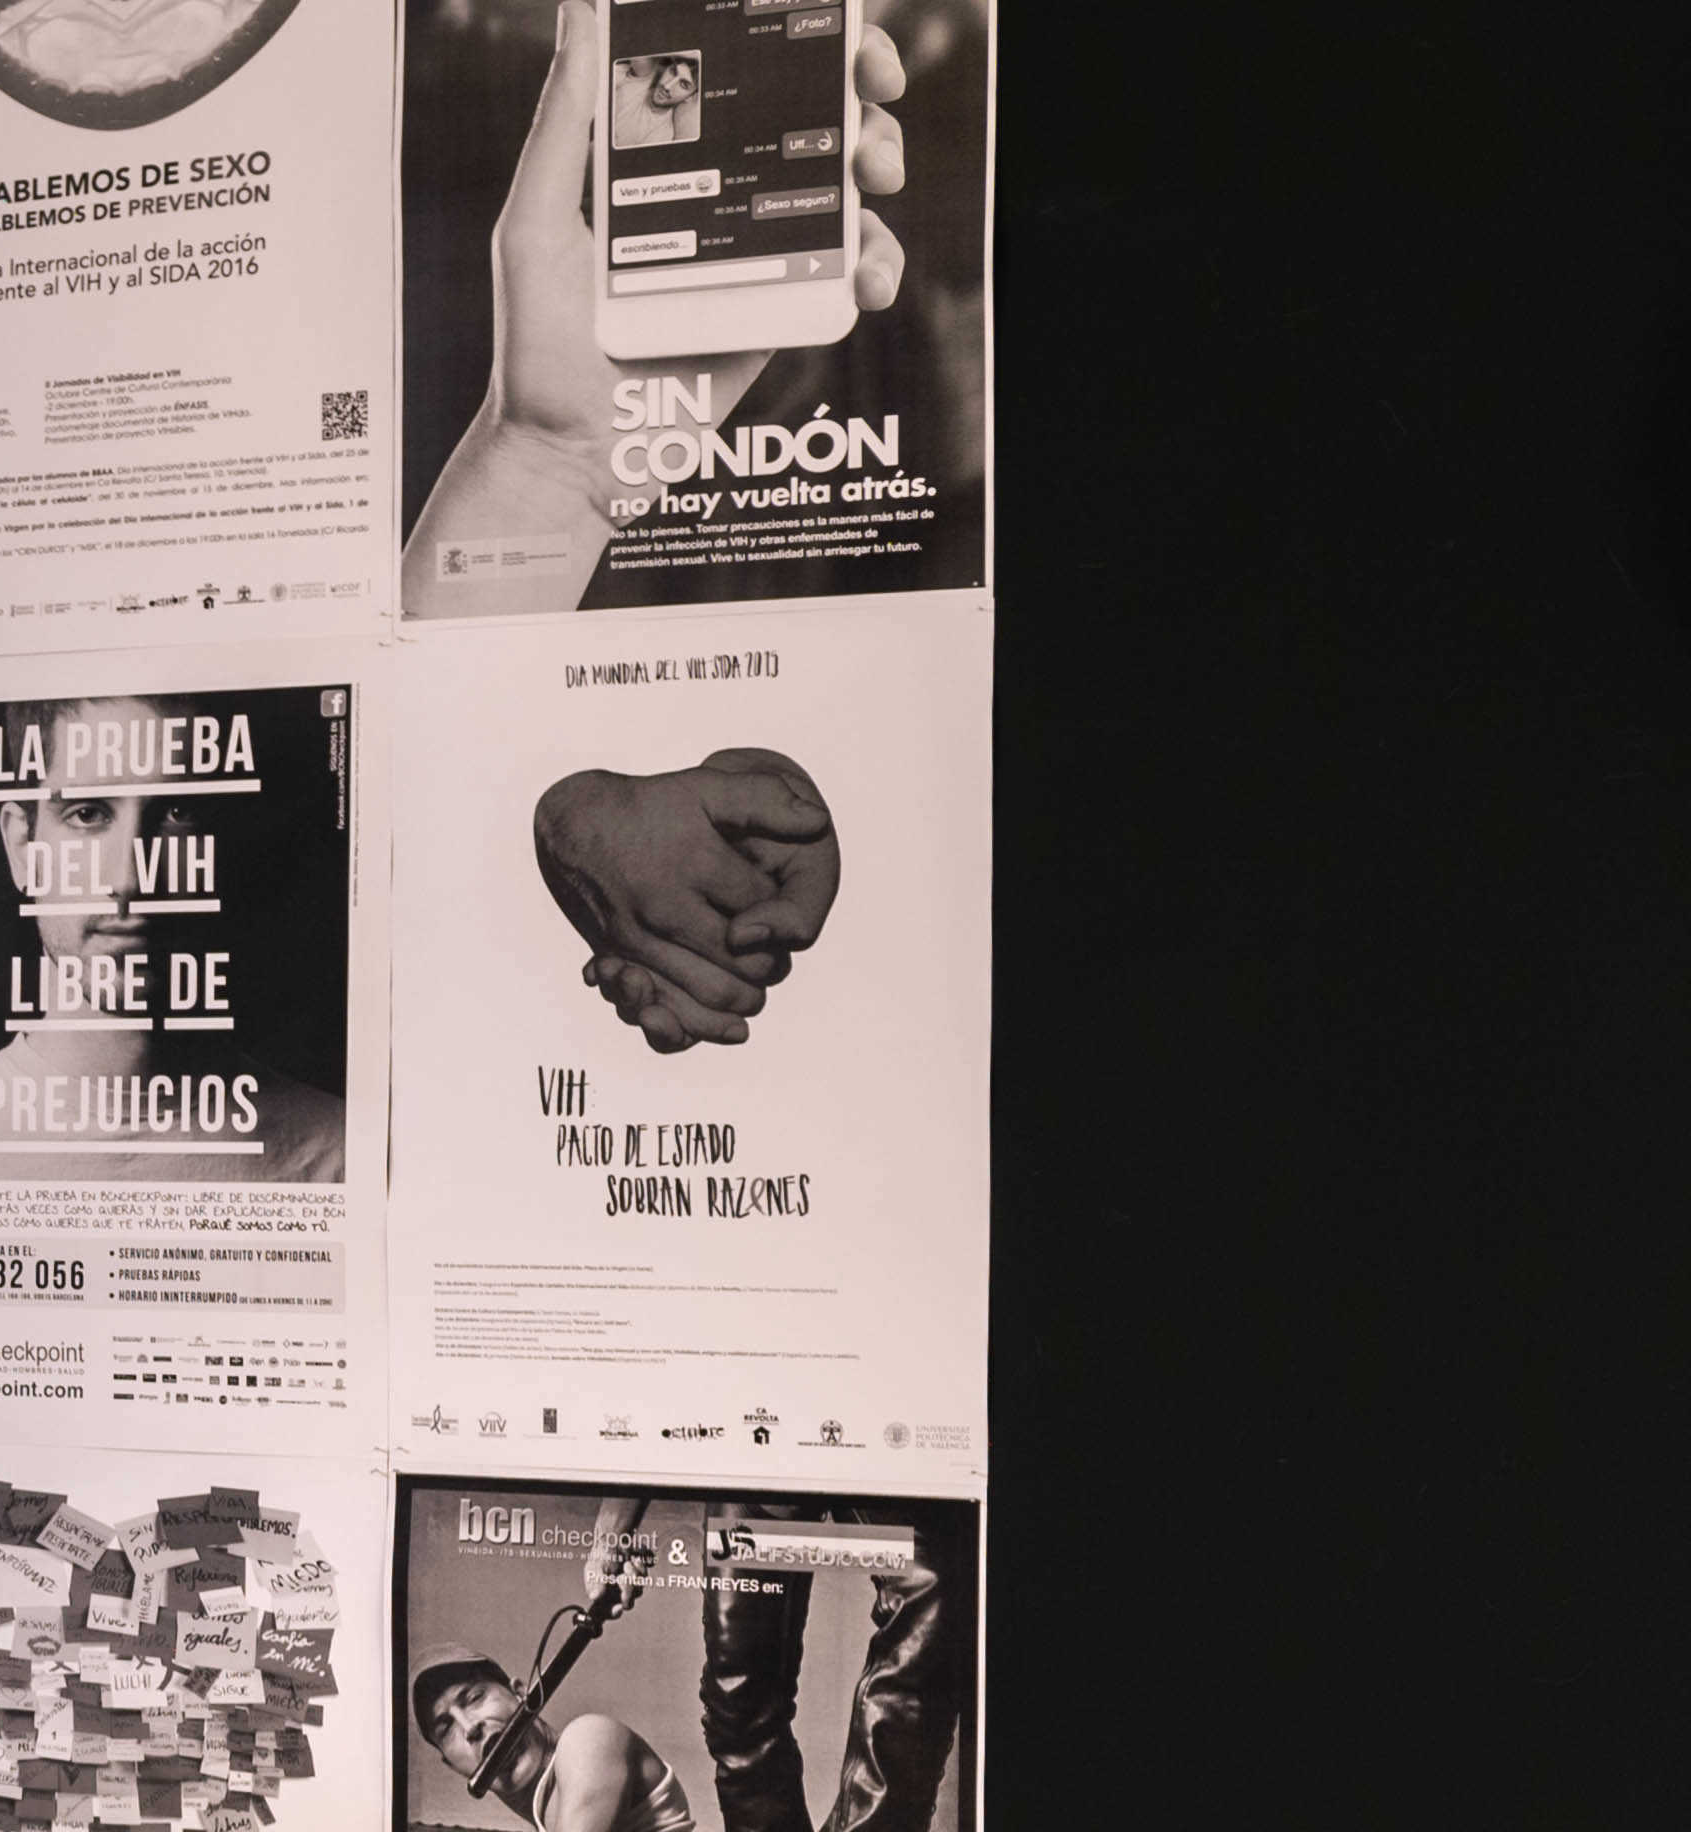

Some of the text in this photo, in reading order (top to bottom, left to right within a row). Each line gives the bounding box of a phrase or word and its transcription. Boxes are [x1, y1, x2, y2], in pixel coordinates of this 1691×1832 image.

[141, 161, 179, 187] DE
[190, 150, 271, 181] SEXO
[651, 182, 691, 195] pruebas
[93, 201, 121, 221] DE
[128, 184, 271, 218] PREVENCIÓN
[10, 246, 138, 276] Internacional
[144, 241, 170, 262] de
[177, 240, 194, 258] la
[200, 233, 266, 257] acción
[43, 277, 59, 296] al
[66, 270, 102, 294] VIH
[109, 276, 120, 294] y
[127, 268, 143, 288] al
[150, 262, 202, 286] SIDA
[207, 257, 259, 279] 2016
[611, 373, 712, 431] SIN
[610, 403, 899, 485] CONDÓN
[611, 470, 937, 519] no hay vuelta atrás.
[697, 523, 728, 534] Tomar
[731, 519, 800, 533] precauciones
[830, 513, 868, 525] manera
[921, 509, 934, 518] de
[592, 661, 651, 685] MUNDIAL
[656, 659, 679, 680] DEL
[66, 714, 256, 779] PRUEBA
[26, 834, 215, 897] DEL VIH
[10, 952, 230, 1013] LIBRE DE
[557, 1123, 735, 1167] PACTO DE ESTADO
[607, 1174, 691, 1217] SOBRAN
[36, 1260, 84, 1289] 056
